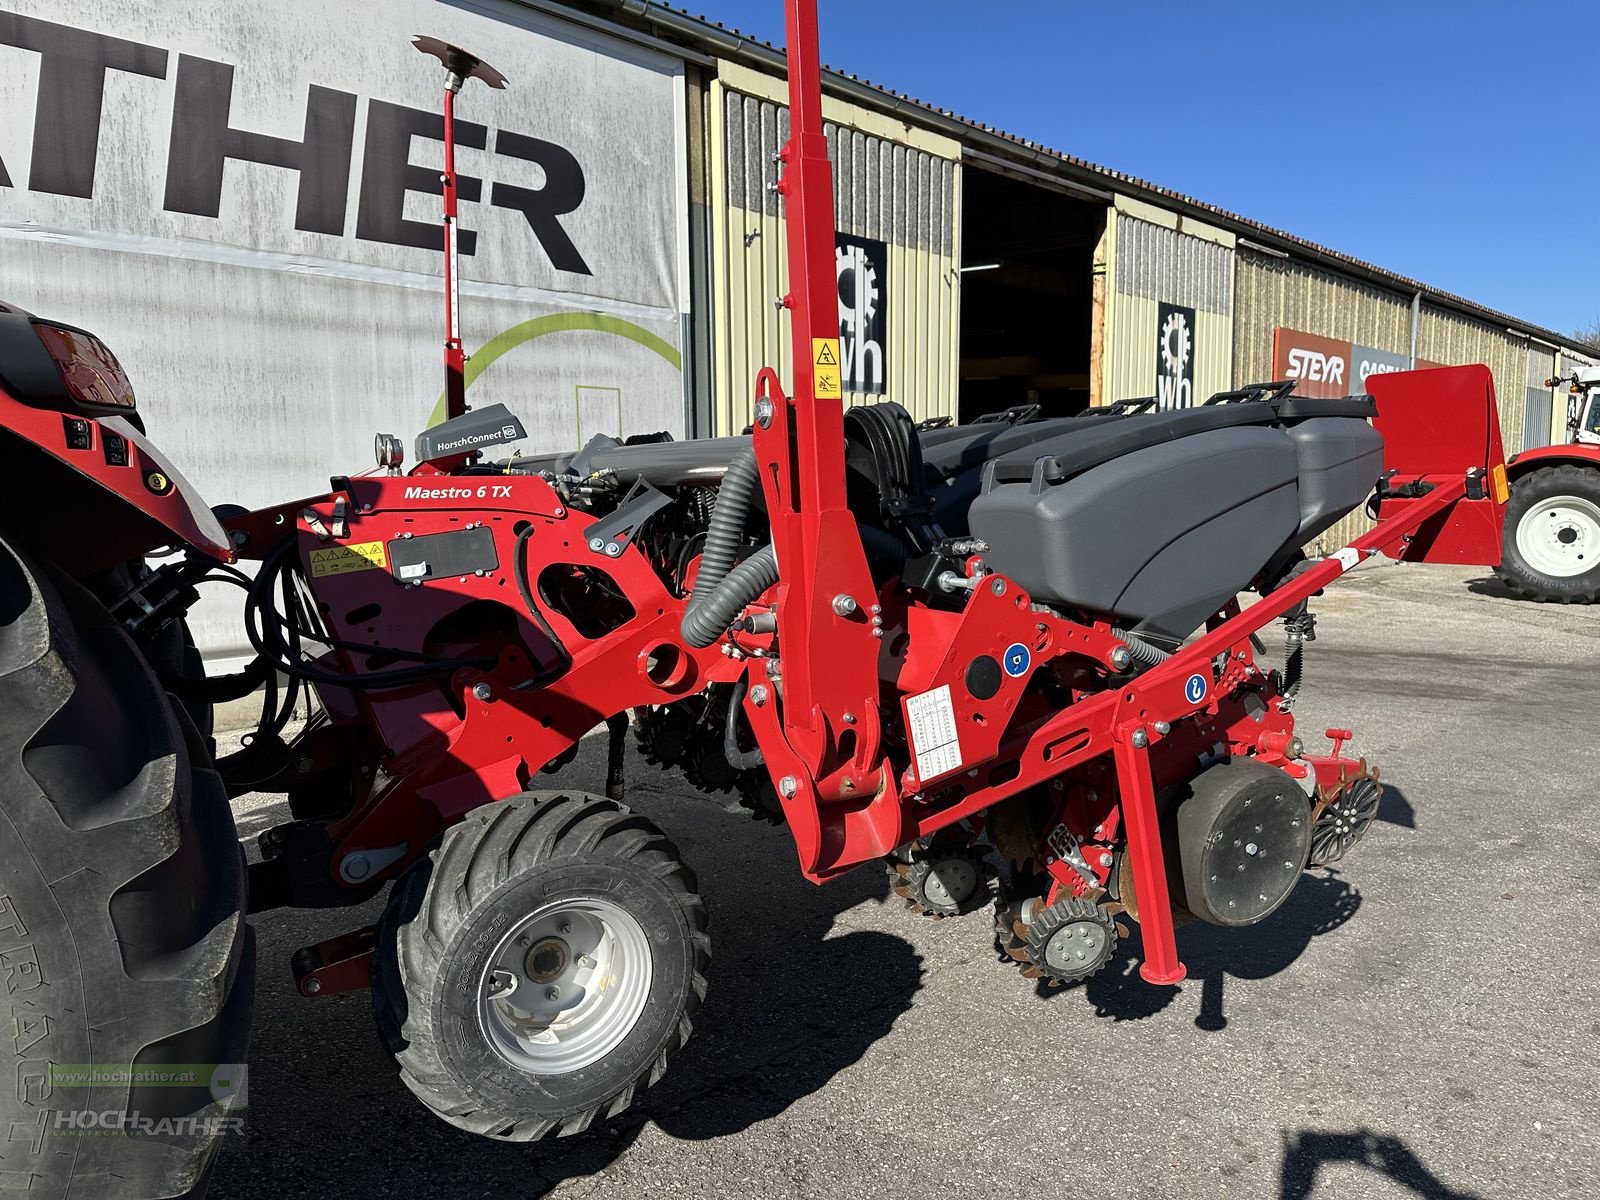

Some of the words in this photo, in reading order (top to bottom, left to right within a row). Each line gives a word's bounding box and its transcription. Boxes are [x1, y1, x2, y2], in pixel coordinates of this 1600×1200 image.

[0, 10, 593, 276] THER
[1286, 347, 1345, 385] STEYR
[437, 430, 502, 451] HorschConnect
[404, 486, 472, 499] Maestro
[476, 486, 487, 499] 6
[491, 485, 513, 498] TX
